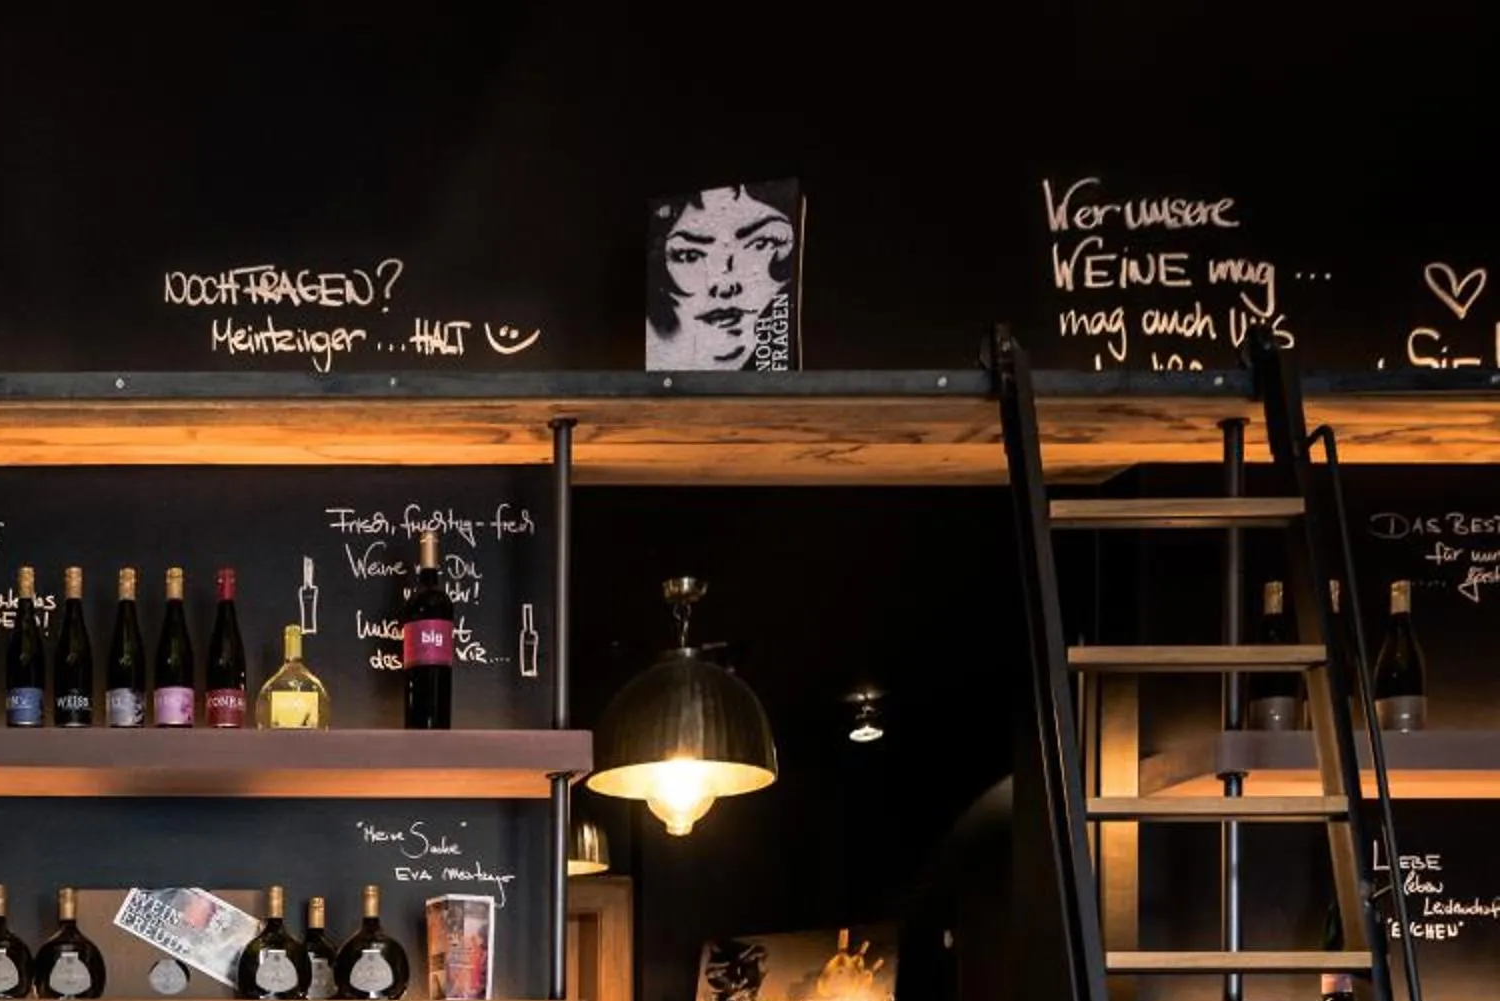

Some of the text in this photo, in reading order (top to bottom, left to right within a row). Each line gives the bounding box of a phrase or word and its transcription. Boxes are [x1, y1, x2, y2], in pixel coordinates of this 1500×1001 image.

[1208, 256, 1277, 317] mag
[771, 292, 789, 371] FRAGEN
[1059, 306, 1128, 362] mag
[1141, 301, 1217, 340] auch
[421, 630, 443, 646] big
[1372, 840, 1443, 871] LEBE
